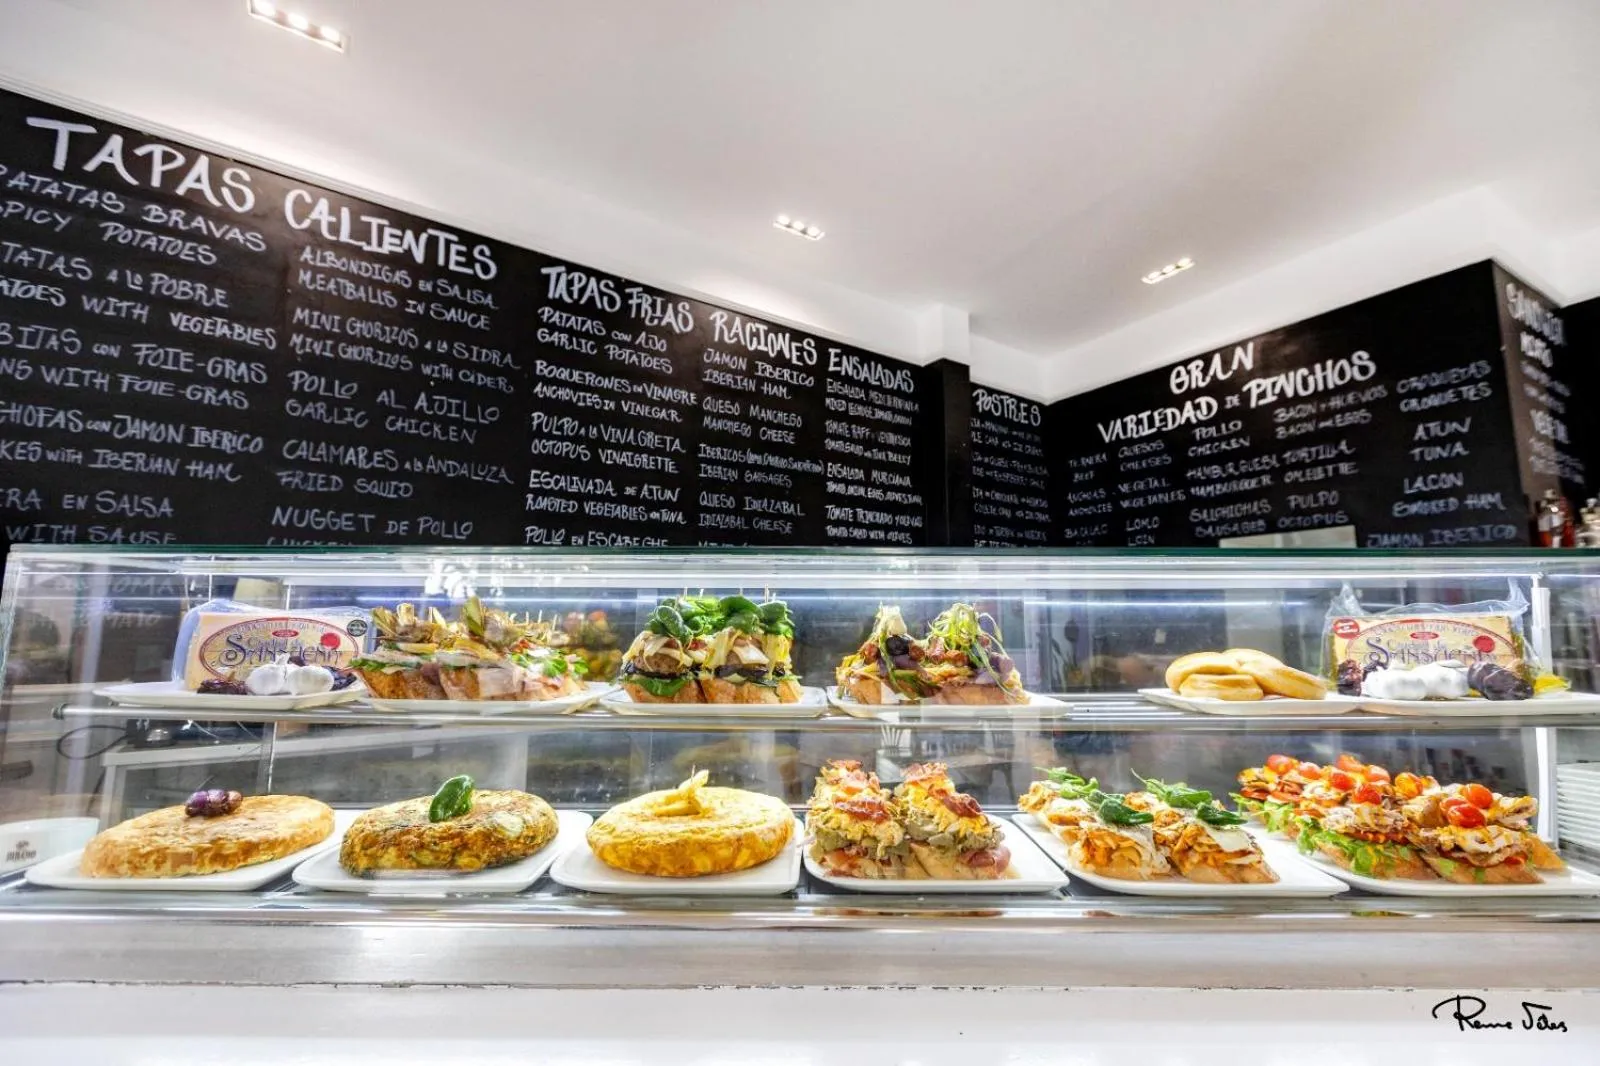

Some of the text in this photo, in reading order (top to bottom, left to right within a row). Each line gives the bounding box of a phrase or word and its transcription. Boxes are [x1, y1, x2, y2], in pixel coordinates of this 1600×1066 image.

[26, 116, 498, 281] TAPAS CALIENTES
[0, 201, 217, 265] PICY POTATOES
[141, 204, 267, 251] BRAVAS
[151, 272, 229, 308] POBRE
[300, 246, 499, 310] ALBONDIGAS EN SALSA
[298, 268, 491, 331] MEATBALLS IN SAUCE
[540, 266, 694, 334] TAPAS FRIAS
[81, 295, 277, 350] WITH VEGETABLES
[292, 307, 341, 332] MINI
[453, 341, 522, 370] SIDRA
[537, 306, 606, 336] PATATAS
[635, 331, 667, 352] AJO
[709, 311, 818, 366] RACIONES
[132, 343, 268, 384] FOIE-GRAS
[289, 334, 335, 358] MINI
[420, 363, 454, 381] WITH
[536, 328, 673, 375] GARLIC POTATOES
[703, 347, 815, 387] JAMON IBERICO
[535, 359, 632, 394] BOQUERONES
[643, 382, 698, 405] VINAGRE
[702, 368, 792, 400] IBERIAN HAM
[827, 347, 915, 394] ENSALADAS
[1169, 342, 1254, 395] GRAN
[41, 364, 110, 393] WITH
[117, 373, 249, 410] FOIE-GRAS
[287, 370, 500, 424] POLLO AL AJILLO
[533, 381, 601, 409] ANCHOVIES
[621, 400, 683, 423] VINEGAR
[1097, 396, 1218, 443] VARIEDAD
[1242, 350, 1376, 409] PINCHOS
[285, 398, 477, 445] GARLIC CHICKEN
[702, 396, 802, 428] QUESO MANCHEGO
[972, 388, 1041, 427] POSTRES
[1273, 403, 1317, 423] BACON
[113, 414, 184, 444] JAMON
[531, 411, 579, 436] PULPO
[600, 424, 687, 454] VINAGRETA
[703, 415, 796, 444] MANCHEGO CHEESE
[1192, 420, 1243, 442] POLLO
[1275, 420, 1316, 439] BACON
[1413, 416, 1472, 442] ATUN
[282, 438, 399, 473] CALAMARES
[425, 455, 514, 485] ANDALUZA
[531, 438, 679, 474] OCTOPUS VINAIGRETTE
[698, 443, 745, 462] IBERICOS
[1187, 436, 1250, 457] CHICKEN
[1409, 441, 1470, 461] TUNA
[185, 460, 242, 482] HAM
[276, 470, 413, 498] FRIED SQUID
[698, 463, 738, 482] IBERIAN
[827, 462, 912, 488] ENSALADA MURCIANA
[1118, 476, 1171, 494] VEGETAL
[1403, 471, 1464, 494] LACON
[62, 494, 88, 511] EN
[95, 490, 174, 518] SALSA
[624, 486, 637, 496] DE
[639, 483, 681, 502] ATUN
[699, 491, 806, 516] QUESO IDIAZABAL
[1287, 490, 1339, 511] PULPO
[271, 505, 473, 539] NUGGET DE POLLO
[584, 501, 648, 522] VEGETABLES
[660, 508, 687, 525] TUNA
[752, 517, 793, 535] CHEESE
[825, 505, 854, 522] TOMATE
[1126, 516, 1160, 532] LOMO
[1277, 510, 1349, 529] OCTOPUS
[6, 523, 77, 543] WITH
[525, 525, 566, 545] POLLO
[571, 536, 585, 546] EN
[1366, 524, 1518, 548] JAMON IBERICO
